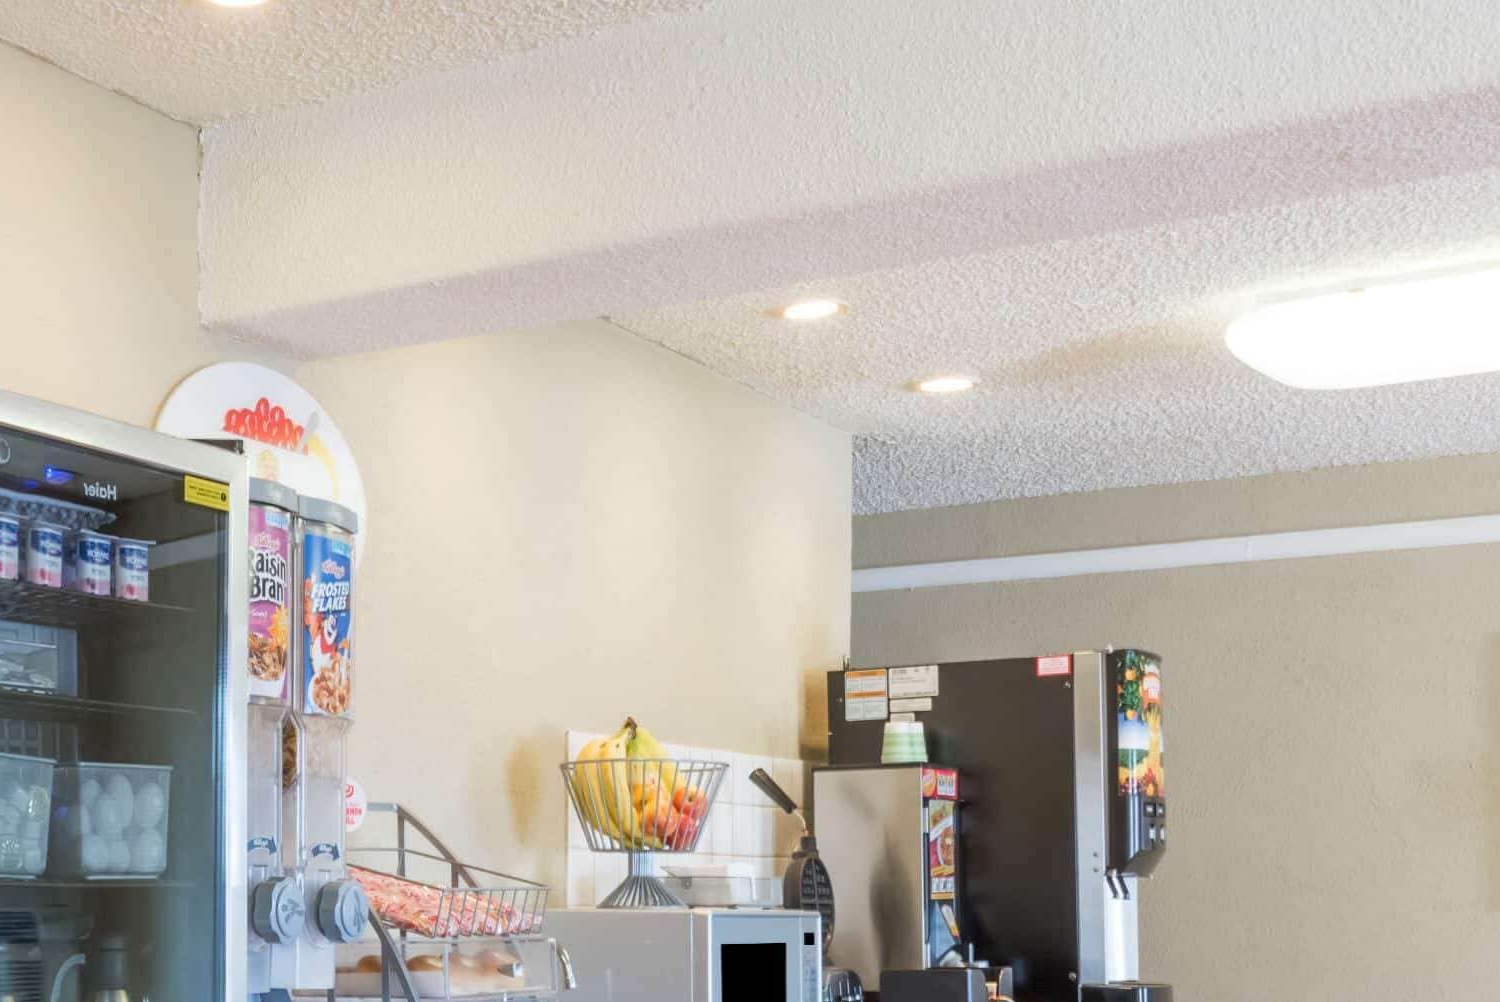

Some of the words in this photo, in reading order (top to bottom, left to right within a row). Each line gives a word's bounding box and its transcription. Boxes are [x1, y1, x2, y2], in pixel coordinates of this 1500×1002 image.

[249, 548, 286, 584] aisin
[311, 581, 350, 598] FROSTED
[312, 596, 347, 613] FLAKES
